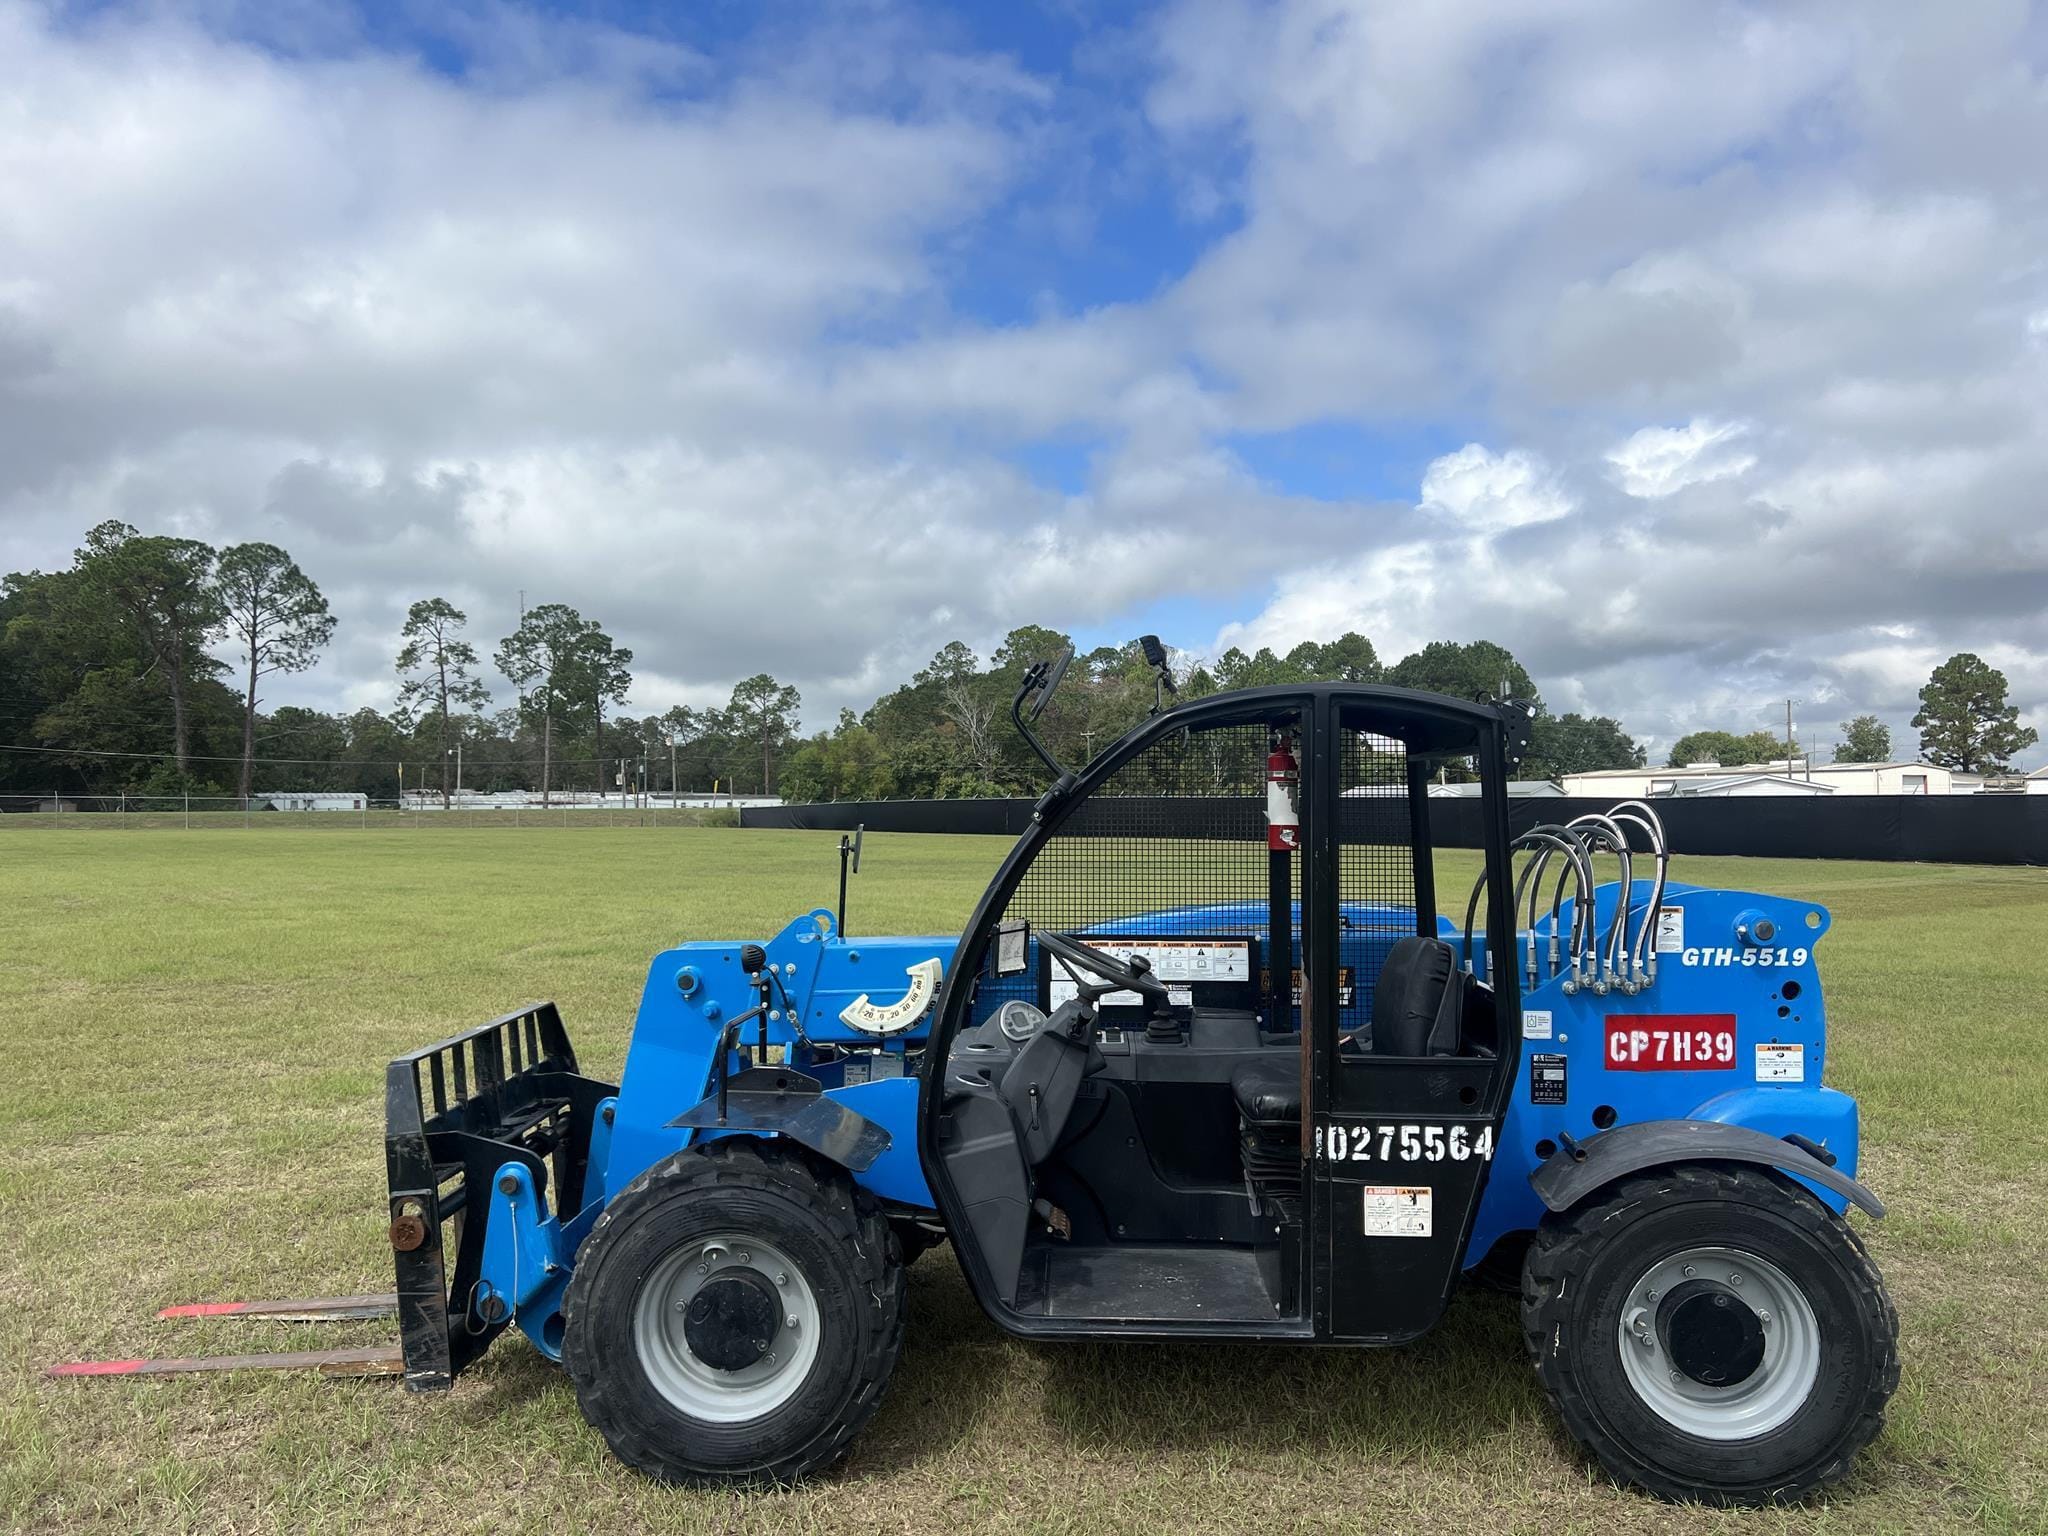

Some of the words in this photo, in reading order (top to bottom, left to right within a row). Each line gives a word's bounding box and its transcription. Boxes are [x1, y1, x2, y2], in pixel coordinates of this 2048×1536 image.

[1682, 948, 1808, 966] GTH-5519
[890, 1011, 900, 1019] 20
[902, 1003, 911, 1012] 40
[1611, 1030, 1734, 1062] CP7H39
